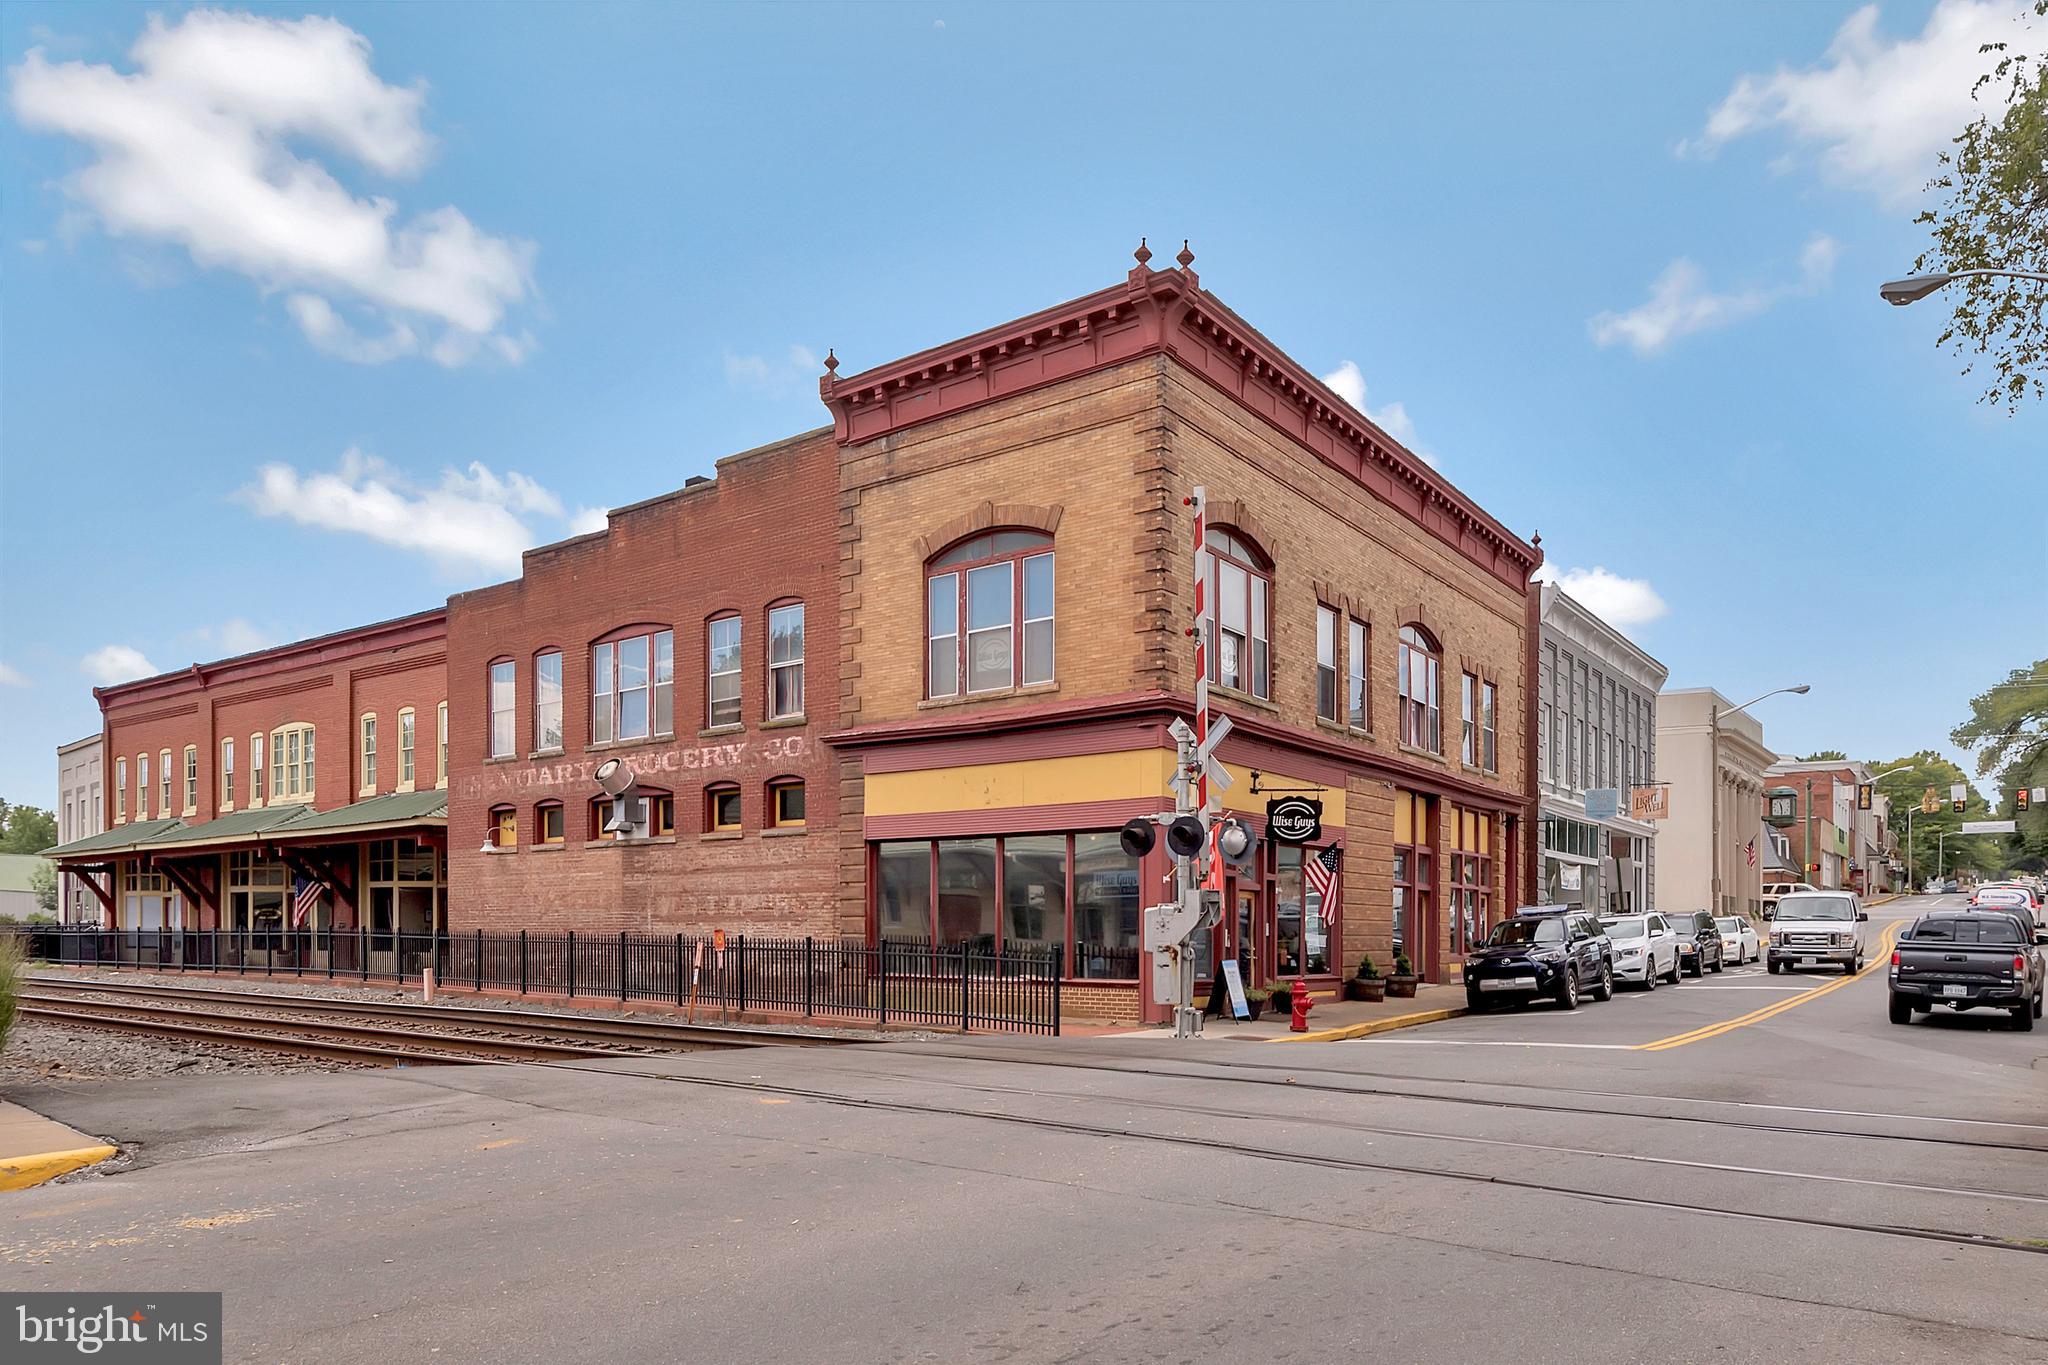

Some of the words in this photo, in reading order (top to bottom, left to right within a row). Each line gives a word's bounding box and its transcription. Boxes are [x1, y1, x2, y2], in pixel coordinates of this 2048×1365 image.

[1636, 793, 1657, 809] LIGHT
[1644, 801, 1666, 813] WELL
[1272, 815, 1293, 827] Wise
[1294, 815, 1315, 829] Guys
